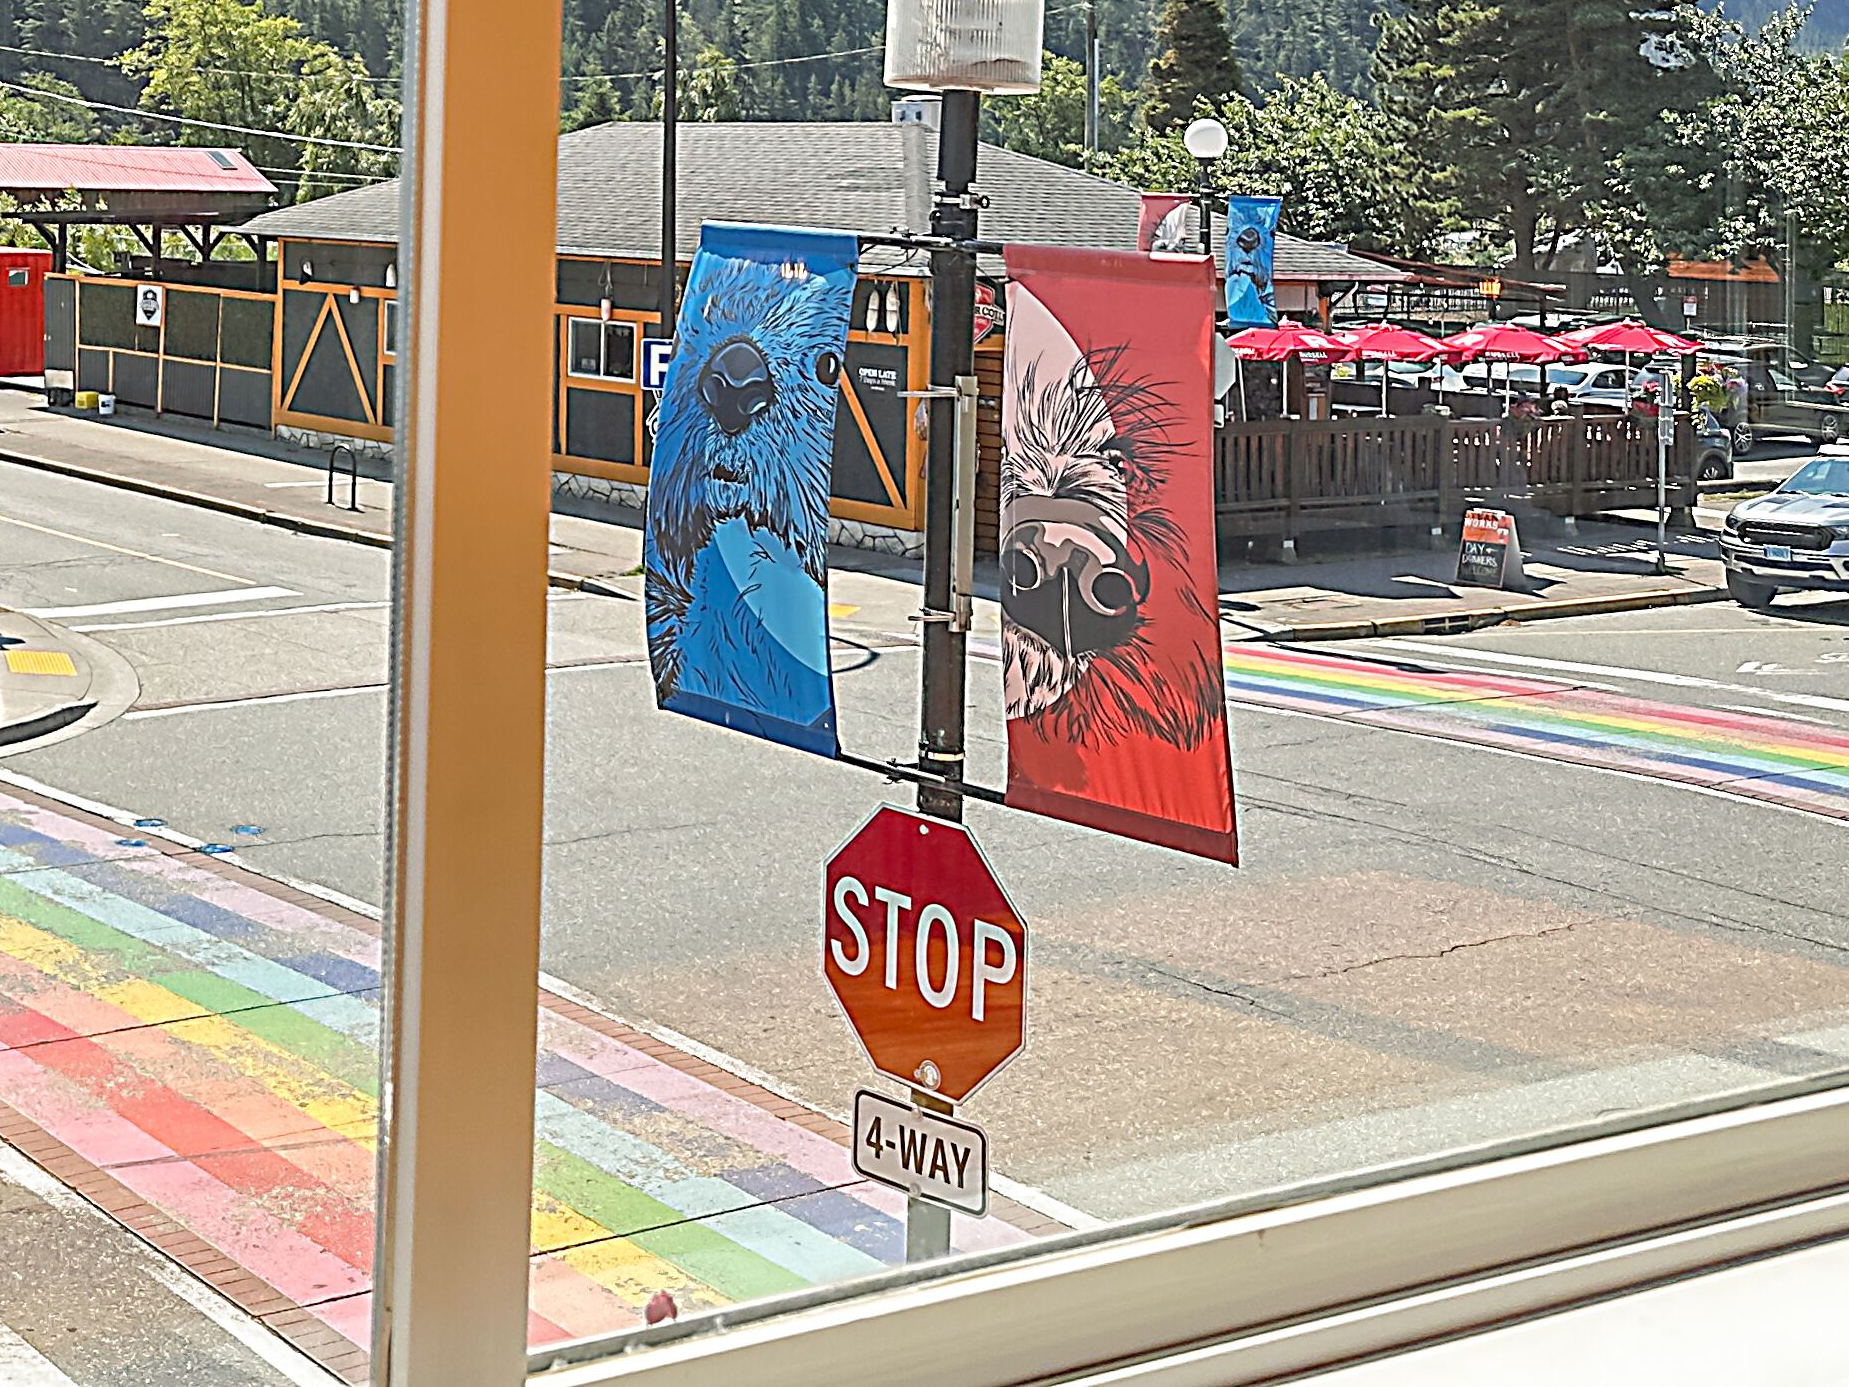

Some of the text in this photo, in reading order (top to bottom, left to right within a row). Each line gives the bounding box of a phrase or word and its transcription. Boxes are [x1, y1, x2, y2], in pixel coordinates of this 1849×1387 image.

[858, 367, 897, 380] OPEN LATE
[1464, 517, 1499, 530] WORKS
[1465, 542, 1486, 555] DAY
[830, 876, 1017, 1022] STOP
[865, 1116, 971, 1189] 4-WAY
